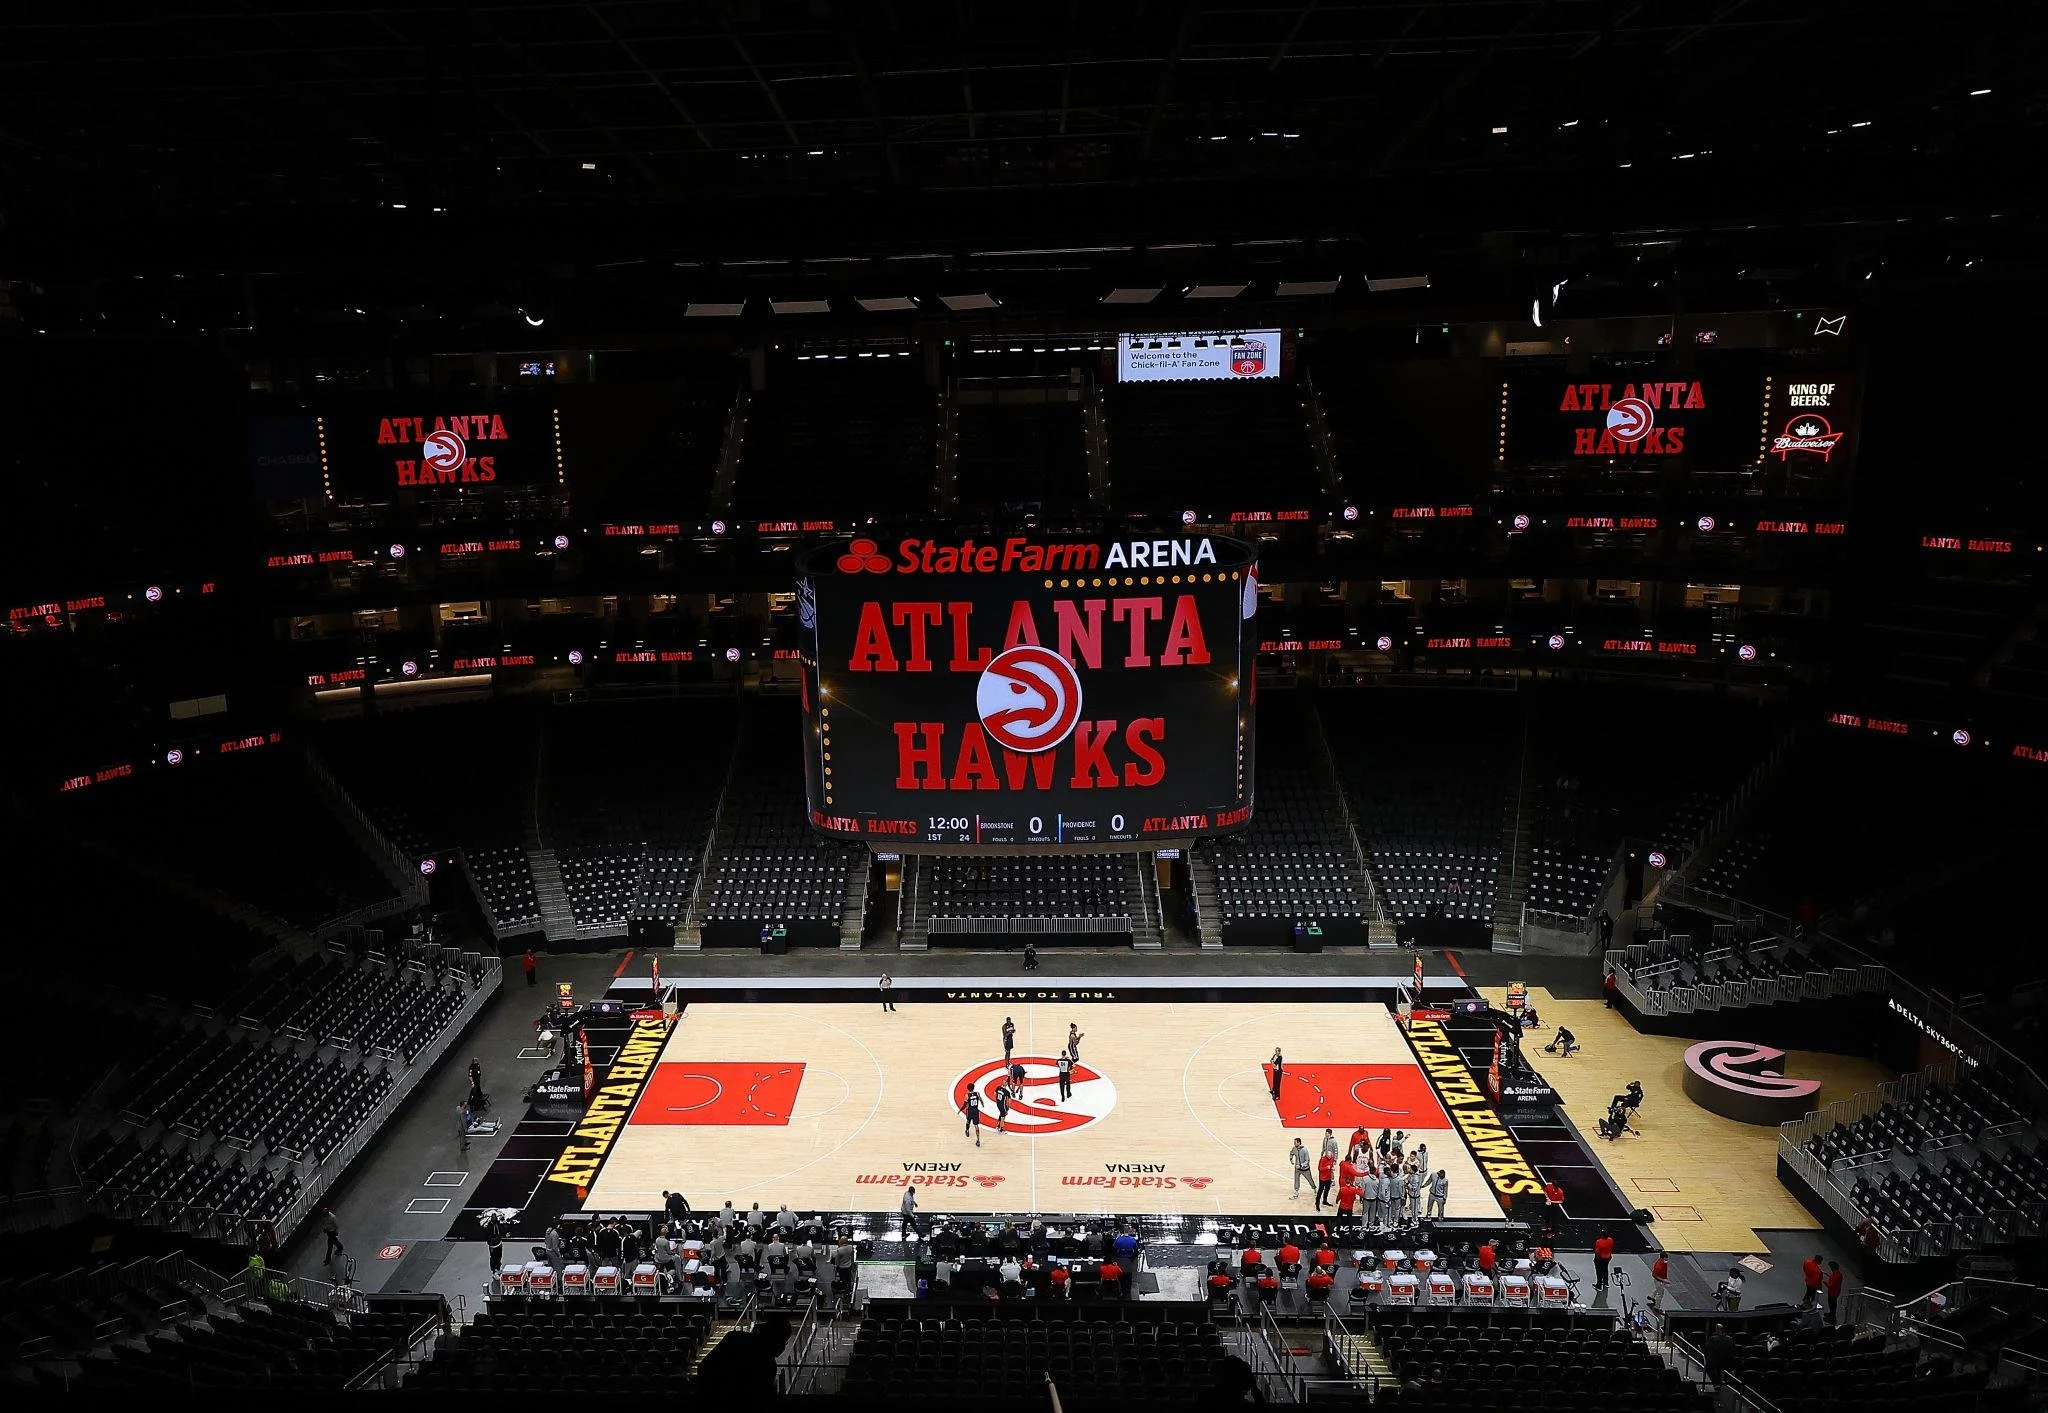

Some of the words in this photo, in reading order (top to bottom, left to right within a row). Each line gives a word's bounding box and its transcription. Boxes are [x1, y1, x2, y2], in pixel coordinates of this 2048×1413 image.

[1131, 352, 1169, 360] Welcome
[1183, 351, 1198, 359] the
[1199, 359, 1220, 367] Zone
[1789, 384, 1817, 395] KING
[1820, 384, 1836, 395] OF
[1559, 382, 1706, 411] ATLANTA
[1790, 395, 1831, 407] BEERS.
[378, 414, 508, 444] ATLANTA
[1774, 437, 1836, 449] Budweiser
[395, 456, 496, 486] HAWKS
[1231, 512, 1272, 521] ATLANTA
[1277, 511, 1308, 520] HAWKS
[1393, 508, 1435, 517] ATLANTA
[1440, 507, 1472, 516] HAWKS
[758, 522, 798, 531] ATLANTA
[803, 521, 833, 530] HAWKS
[1568, 518, 1614, 527] ATLANTA
[1621, 518, 1657, 528] HAWKS
[1757, 521, 1808, 532] ATLANTA
[605, 525, 644, 535] ATLANTA
[649, 525, 679, 534] HAWKS
[441, 543, 483, 553] ATLANTA
[489, 541, 520, 550] HAWKS
[1968, 540, 2011, 552] HAWKS
[268, 554, 314, 566] ATLANTA
[319, 551, 353, 562] HAWKS
[1104, 538, 1217, 570] ARENA
[10, 603, 61, 619] ATLANTA
[67, 597, 104, 610] HAWKS
[848, 594, 1211, 672] ATLANTA
[1260, 641, 1303, 651] ATLANTA
[1309, 640, 1341, 649] HAWKS
[1428, 638, 1471, 648] ATLANTA
[1477, 638, 1510, 647] HAWKS
[1604, 640, 1652, 651] ATLANTA
[1659, 643, 1696, 654] HAWKS
[454, 658, 497, 669] ATLANTA
[502, 656, 534, 665] HAWKS
[616, 651, 656, 662] ATLANTA
[662, 652, 692, 661] HAWKS
[331, 670, 365, 682] HAWKS
[1868, 720, 1907, 733] HAWKS
[221, 736, 264, 752] ATLANTA
[893, 717, 1166, 790] HAWKS
[60, 775, 91, 791] ANTA
[97, 765, 131, 781] HAWKS
[868, 819, 918, 835] HAWKS
[928, 816, 969, 830] 12:00
[1029, 816, 1043, 834] 0
[1062, 820, 1096, 829] PROVIDENCE
[1111, 814, 1125, 832] 0
[1142, 815, 1209, 832] ATLANTA
[927, 833, 943, 841] 1ST
[959, 834, 970, 842] 24
[1896, 1003, 1924, 1030] DELTA
[574, 1040, 584, 1065] xfinity
[1498, 1041, 1508, 1067] xfinity
[547, 1082, 641, 1187] ATLANTA
[606, 1019, 669, 1080] HAWKS
[1408, 1019, 1487, 1106] ATLANTA
[1451, 1109, 1545, 1195] HAWKS
[902, 1162, 962, 1172] ARENA
[1105, 1164, 1166, 1173] ARENA
